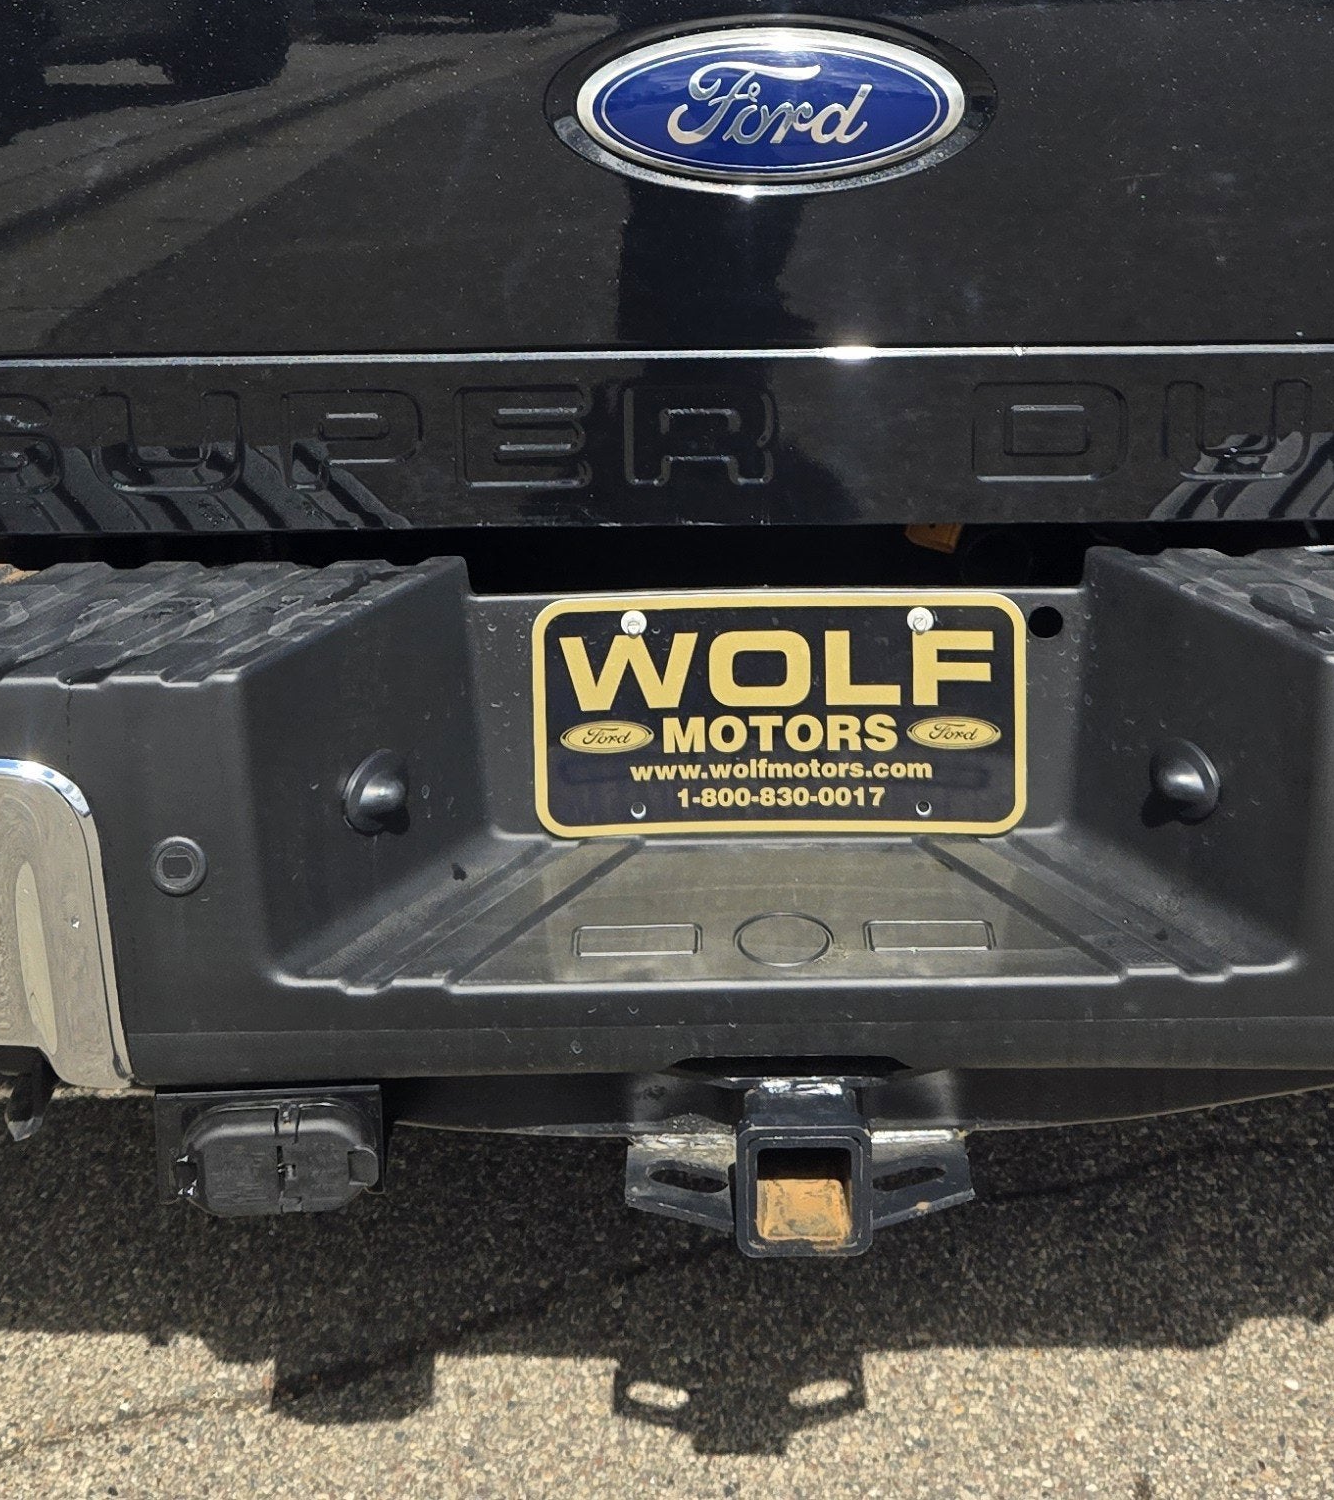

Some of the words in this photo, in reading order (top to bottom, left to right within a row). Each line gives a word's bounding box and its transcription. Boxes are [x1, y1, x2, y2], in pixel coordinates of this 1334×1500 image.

[667, 61, 873, 145] Ford
[559, 630, 994, 711] WOLF
[581, 721, 632, 746] Ford
[662, 714, 898, 753] MOTORS
[927, 716, 978, 742] Ford
[630, 758, 932, 781] www.wolfmotors.com
[677, 786, 886, 807] 1-800-830-0017
